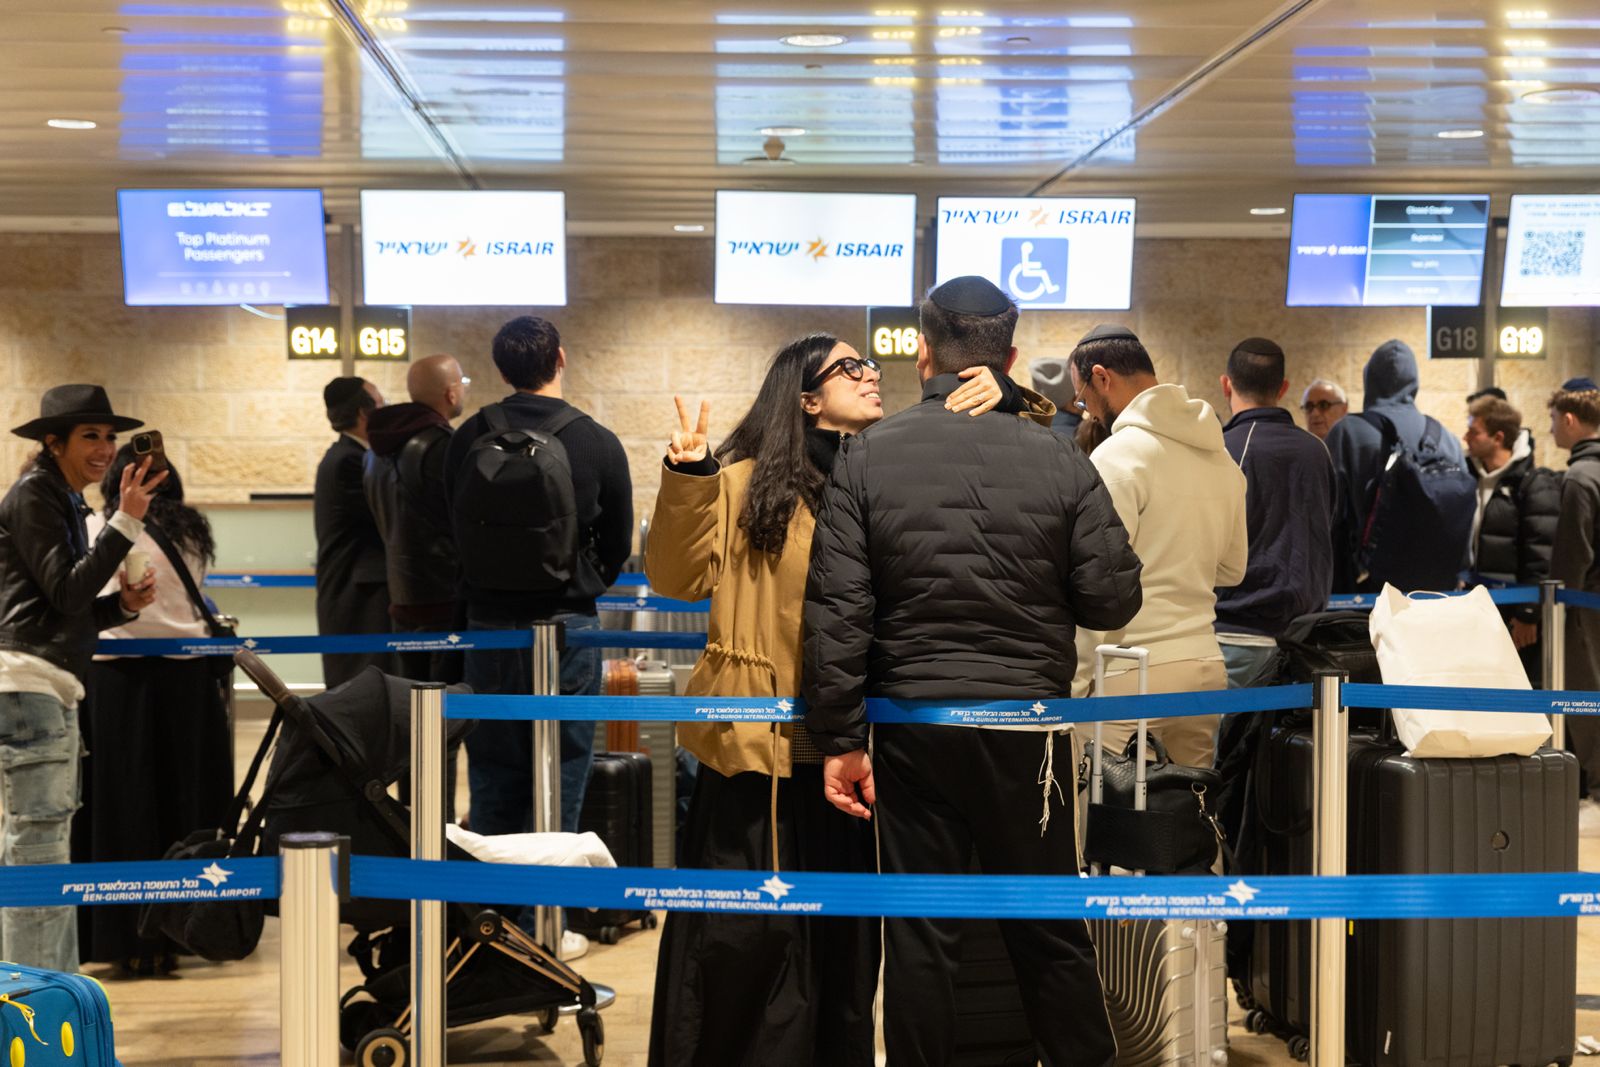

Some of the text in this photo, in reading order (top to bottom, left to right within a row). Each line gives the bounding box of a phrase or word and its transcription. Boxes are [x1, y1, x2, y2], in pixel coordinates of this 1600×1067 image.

[941, 209, 1019, 225] ישראייר
[1058, 209, 1132, 225] ISRAIR
[176, 231, 270, 248] Top Platinum
[374, 239, 448, 255] ישראייר
[184, 246, 265, 264] Passengers
[485, 240, 554, 256] ISRAIR
[727, 240, 800, 256] ישראייר
[835, 242, 904, 257] ISRAIR
[291, 325, 338, 355] G14
[359, 326, 406, 356] G15
[874, 327, 918, 355] G16
[1436, 326, 1477, 352] G18
[1499, 326, 1543, 354] G19
[82, 887, 262, 902] BEN-GURION INTERNATIONAL AIRPORT
[643, 899, 824, 912] BEN-GURION INTERNATIONAL AIRPORT
[1105, 906, 1290, 917] BEN-GURION INTERNATIONAL AIRPORT
